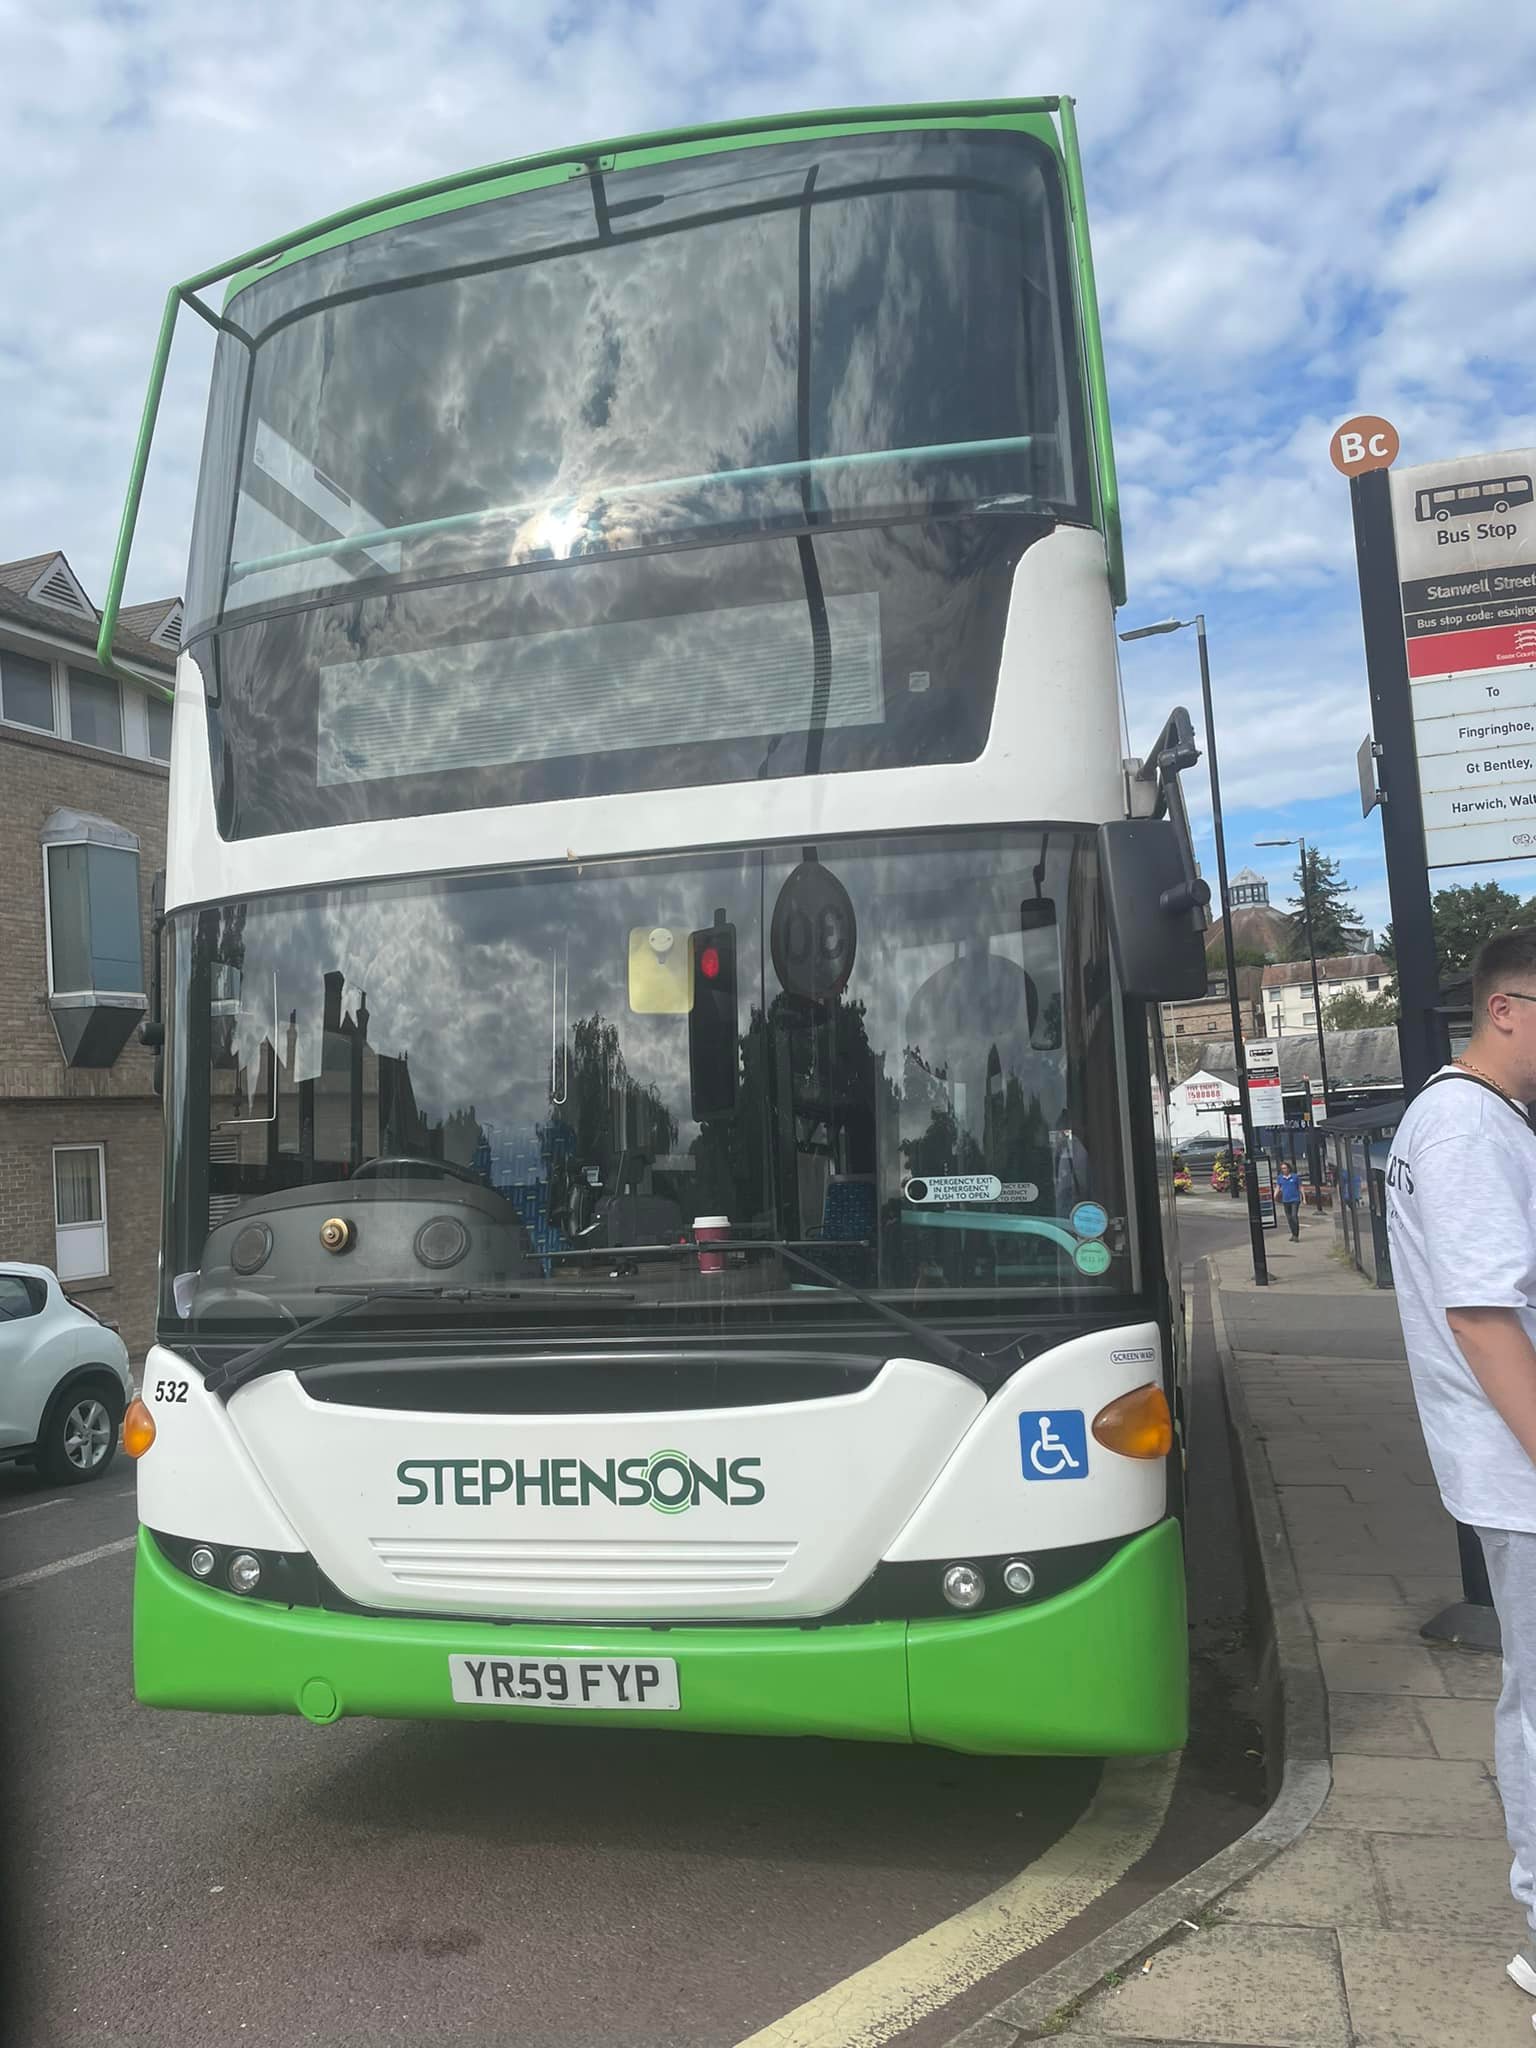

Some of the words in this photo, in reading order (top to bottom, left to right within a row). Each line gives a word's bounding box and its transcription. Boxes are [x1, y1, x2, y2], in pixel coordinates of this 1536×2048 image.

[1340, 432, 1388, 464] Bc
[1437, 529, 1470, 545] Bus
[1477, 523, 1517, 541] Stop
[1427, 578, 1489, 600] Stanwell
[1417, 618, 1437, 629] Bus
[1440, 614, 1462, 626] stop
[1466, 610, 1494, 622] code:
[1485, 686, 1500, 698] To
[1459, 721, 1534, 739] Fingringhoe,
[1466, 763, 1480, 774] Gt
[1484, 757, 1533, 772] Bentley,
[1452, 797, 1507, 814] Harwich,
[929, 1178, 975, 1186] EMERGENCY
[977, 1176, 994, 1184] EXIT
[1387, 1155, 1414, 1195] CTS
[944, 1184, 989, 1192] EMERGENCY
[1113, 1352, 1139, 1361] SCREEN
[155, 1381, 189, 1403] 532
[396, 1455, 766, 1507] STEPHENSONS
[463, 1660, 569, 1701] YR59
[579, 1664, 660, 1703] FYP
